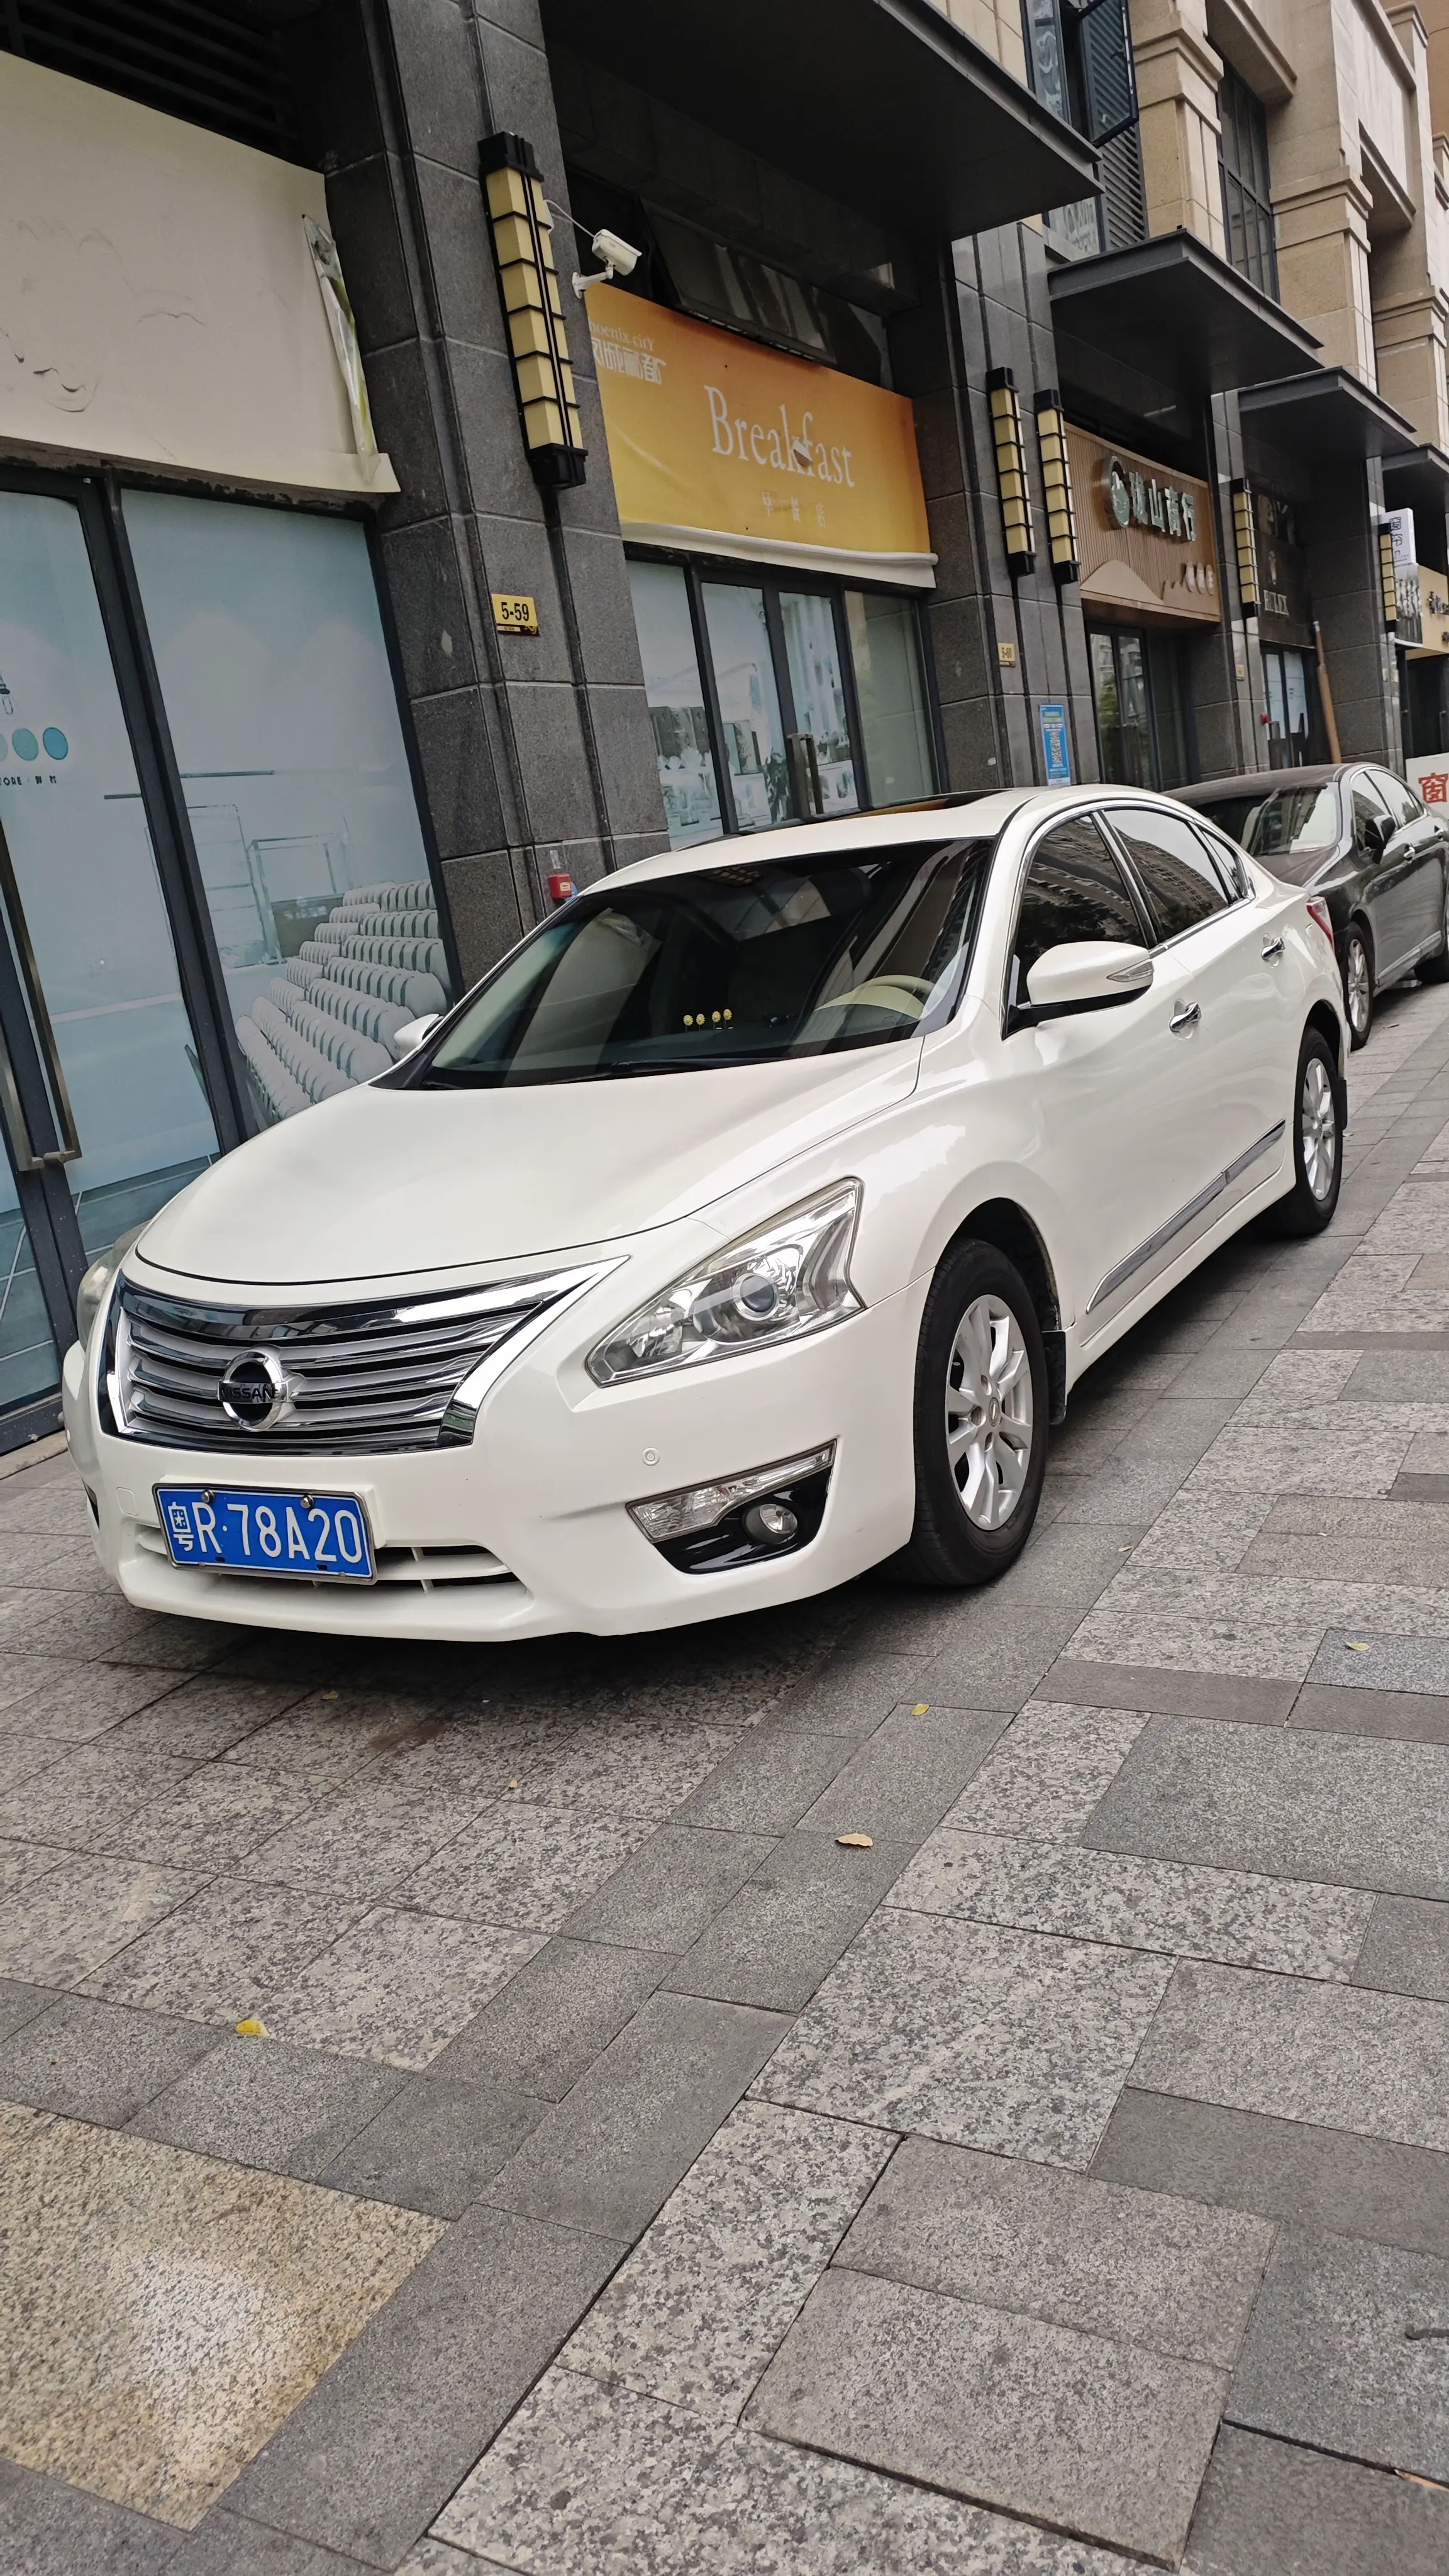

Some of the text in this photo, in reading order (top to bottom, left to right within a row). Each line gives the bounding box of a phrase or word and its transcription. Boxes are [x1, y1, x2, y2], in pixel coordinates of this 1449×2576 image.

[704, 385, 855, 487] Breakfast
[501, 601, 530, 621] 5-59
[220, 1385, 276, 1402] NISSAN
